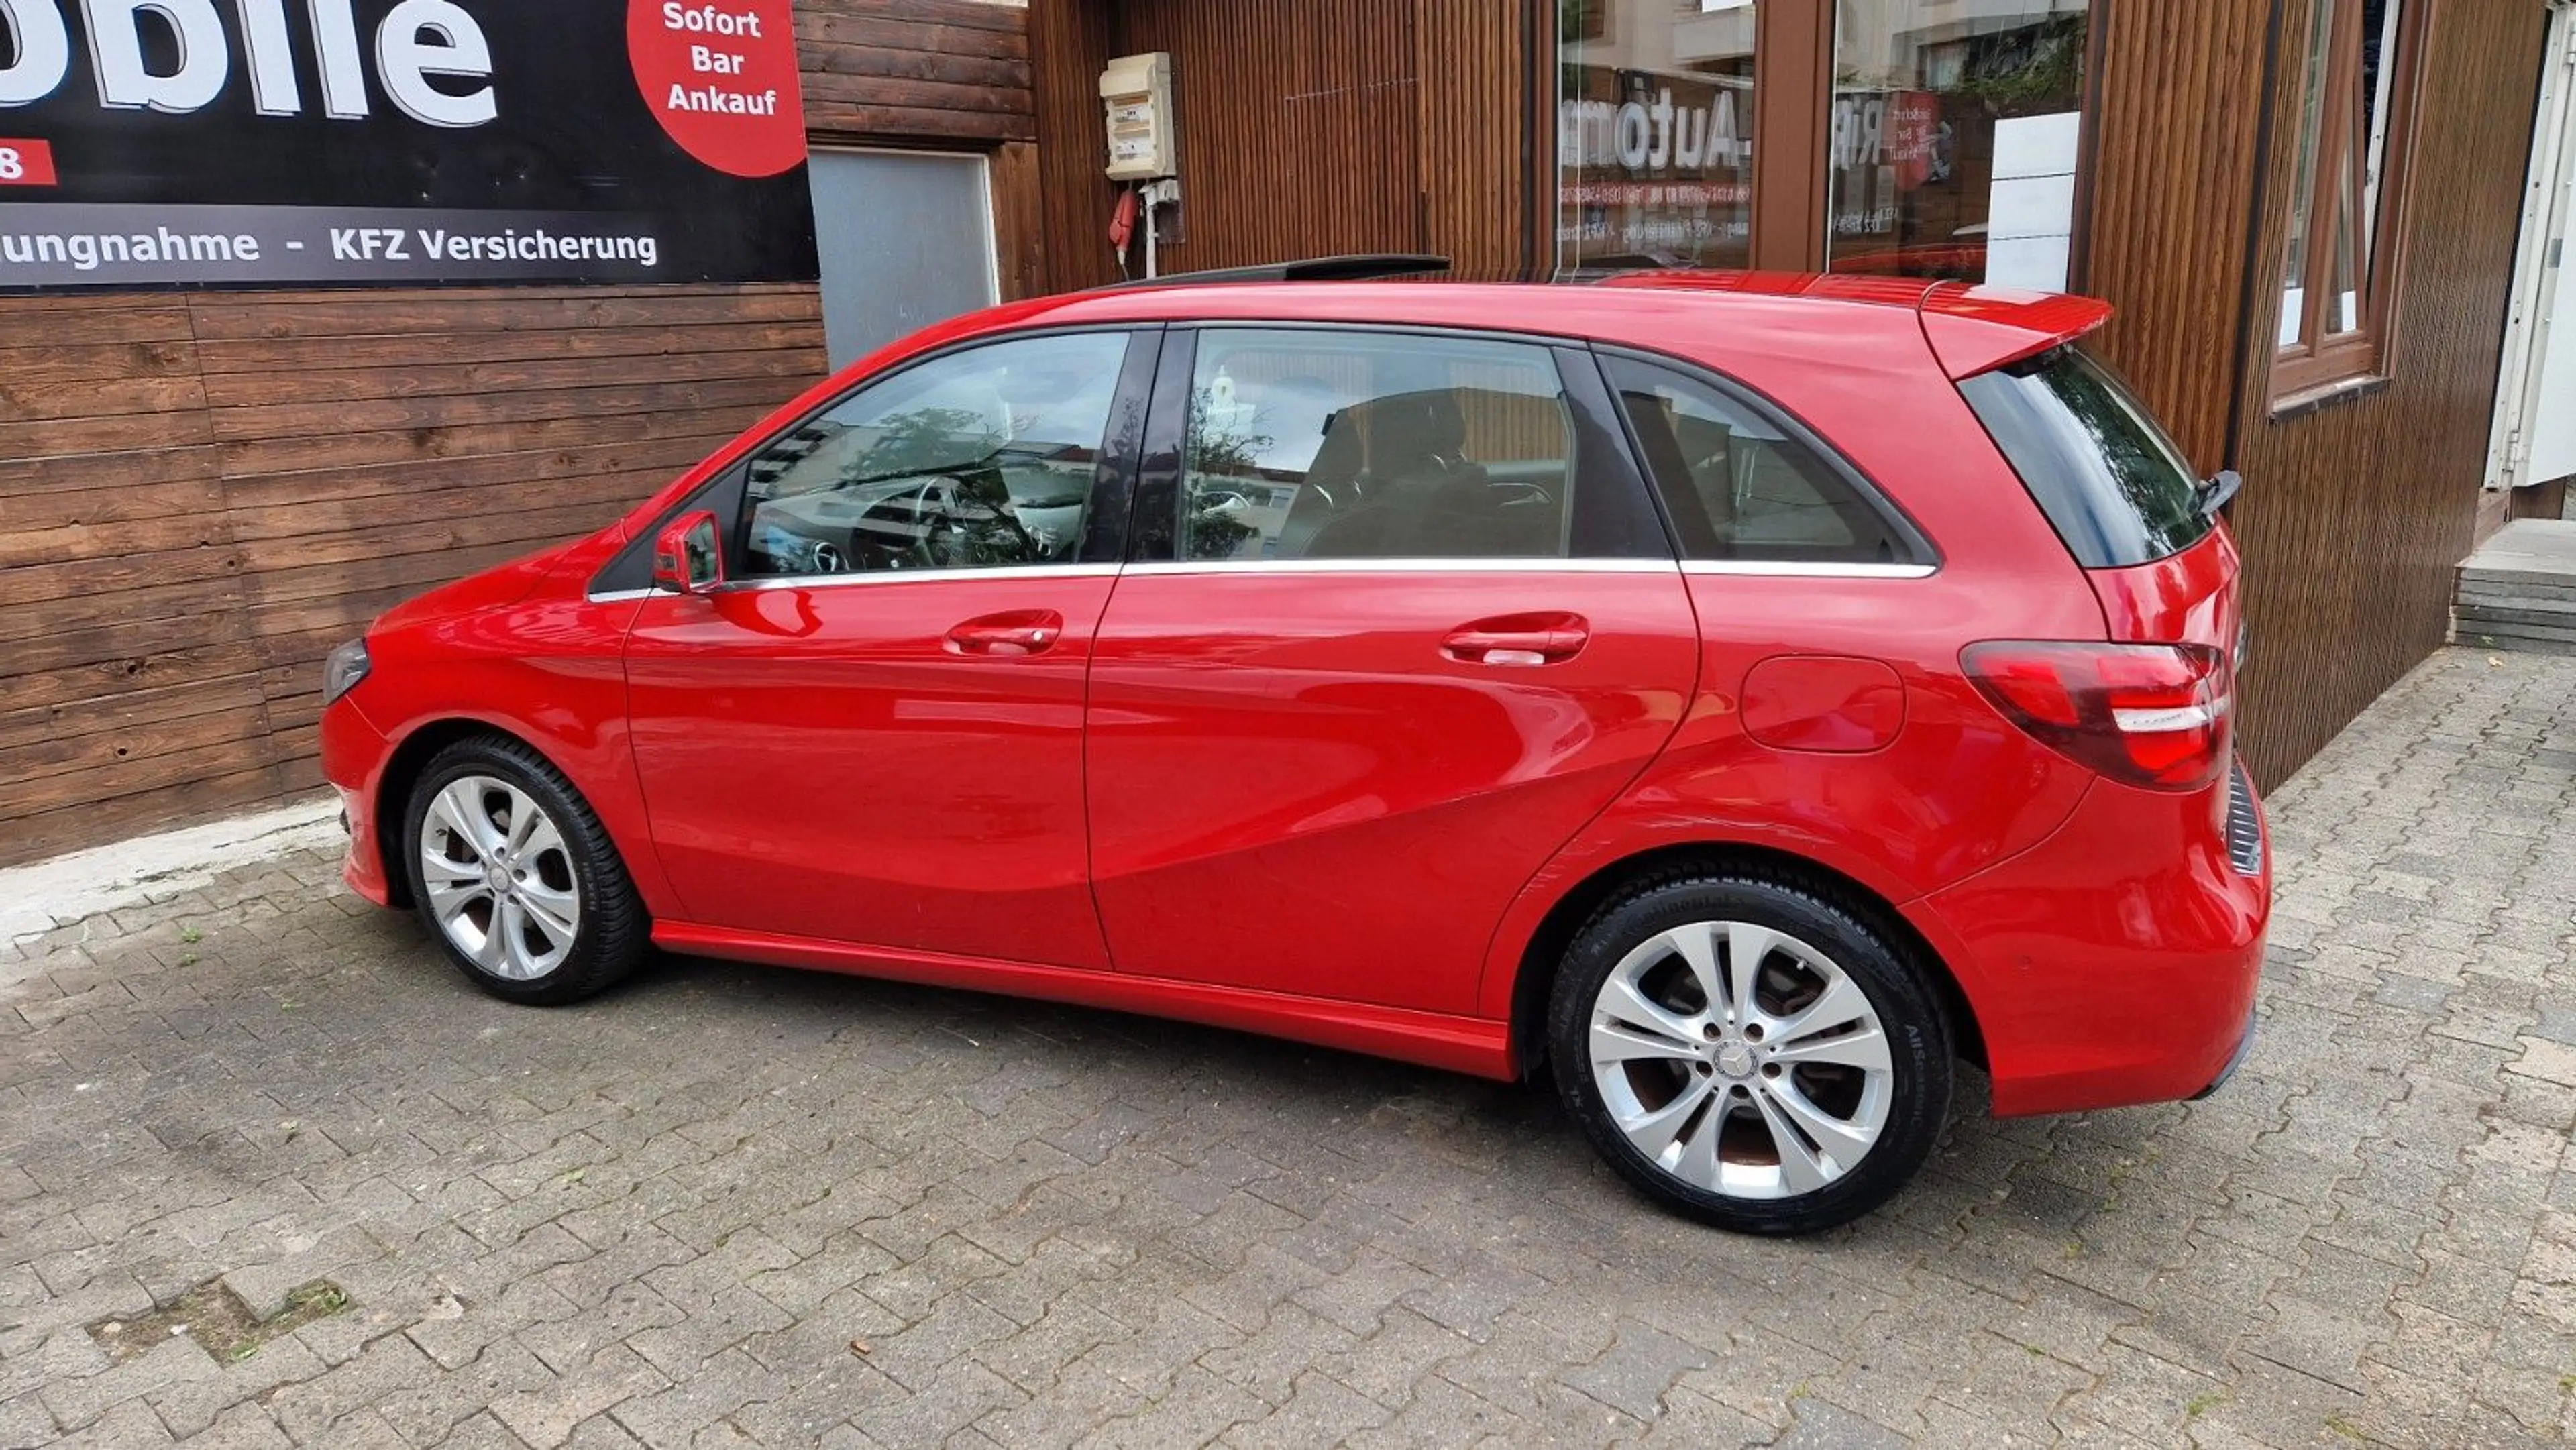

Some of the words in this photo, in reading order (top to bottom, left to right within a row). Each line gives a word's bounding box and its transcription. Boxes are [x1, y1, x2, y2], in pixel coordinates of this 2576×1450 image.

[663, 2, 762, 38] Sofort
[691, 44, 745, 74] Bar
[667, 83, 777, 115] Ankauf
[330, 228, 410, 261] KFZ
[418, 229, 657, 266] Versicherung
